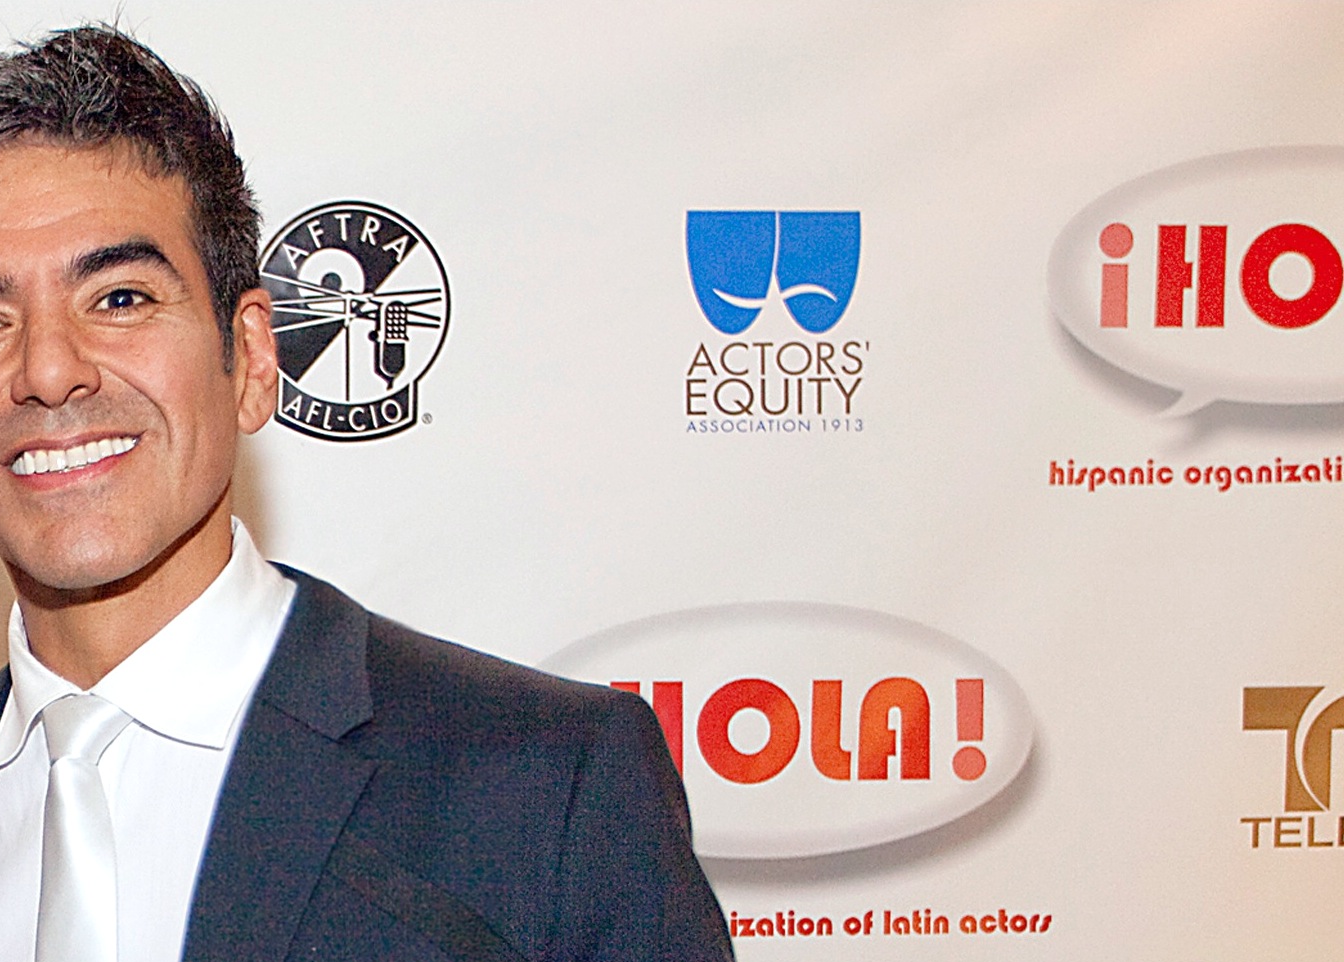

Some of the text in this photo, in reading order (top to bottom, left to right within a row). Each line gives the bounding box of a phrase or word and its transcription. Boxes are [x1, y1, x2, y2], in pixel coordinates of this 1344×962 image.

[281, 212, 410, 270] AFTRA
[687, 341, 870, 376] ACTORS'
[283, 396, 403, 432] AFL-CIO
[685, 378, 862, 416] EQUITY
[686, 418, 864, 434] ASSOCIATION 1913
[1048, 458, 1175, 492] hispanic
[1239, 816, 1344, 849] TEL
[843, 910, 874, 937] of
[883, 910, 949, 936] latin
[958, 908, 1053, 935] actors
